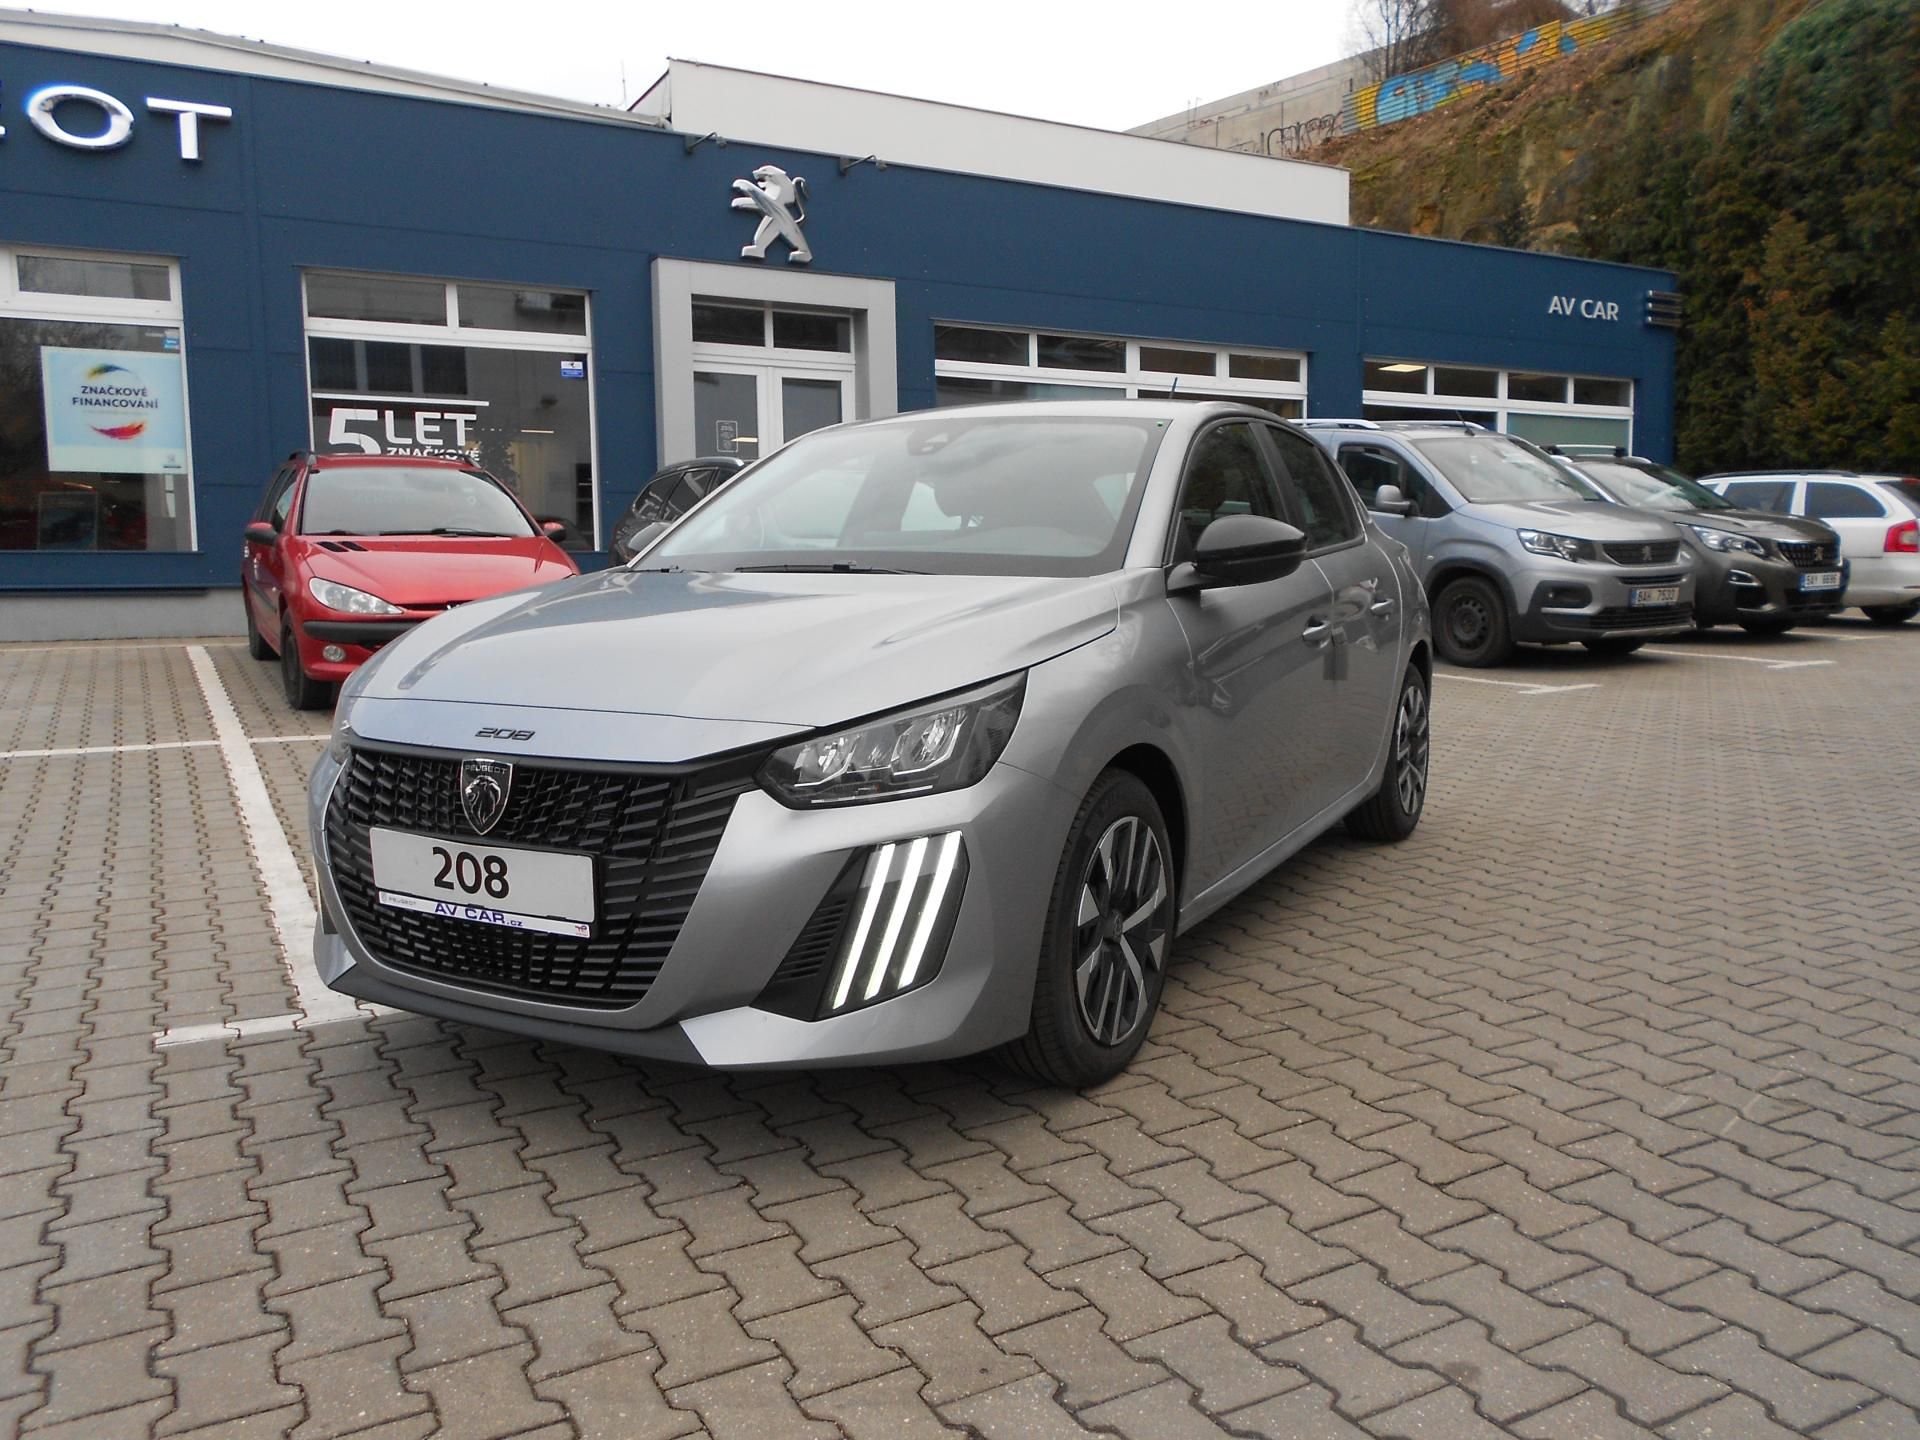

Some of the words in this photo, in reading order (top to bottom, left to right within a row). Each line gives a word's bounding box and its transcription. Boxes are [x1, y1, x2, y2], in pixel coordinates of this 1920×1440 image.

[0, 84, 233, 161] OT
[1548, 296, 1576, 316] AV
[1581, 300, 1619, 321] CAR
[72, 397, 159, 409] FINANCOVÁNÍ
[81, 385, 148, 397] ZNAČKOVÉ
[329, 408, 382, 454] 5
[385, 409, 477, 447] LET
[475, 727, 536, 741] 208
[465, 764, 508, 775] PEUGEOT
[432, 846, 510, 899] 208
[434, 902, 458, 916] AV
[465, 907, 524, 927] CAR.cz
